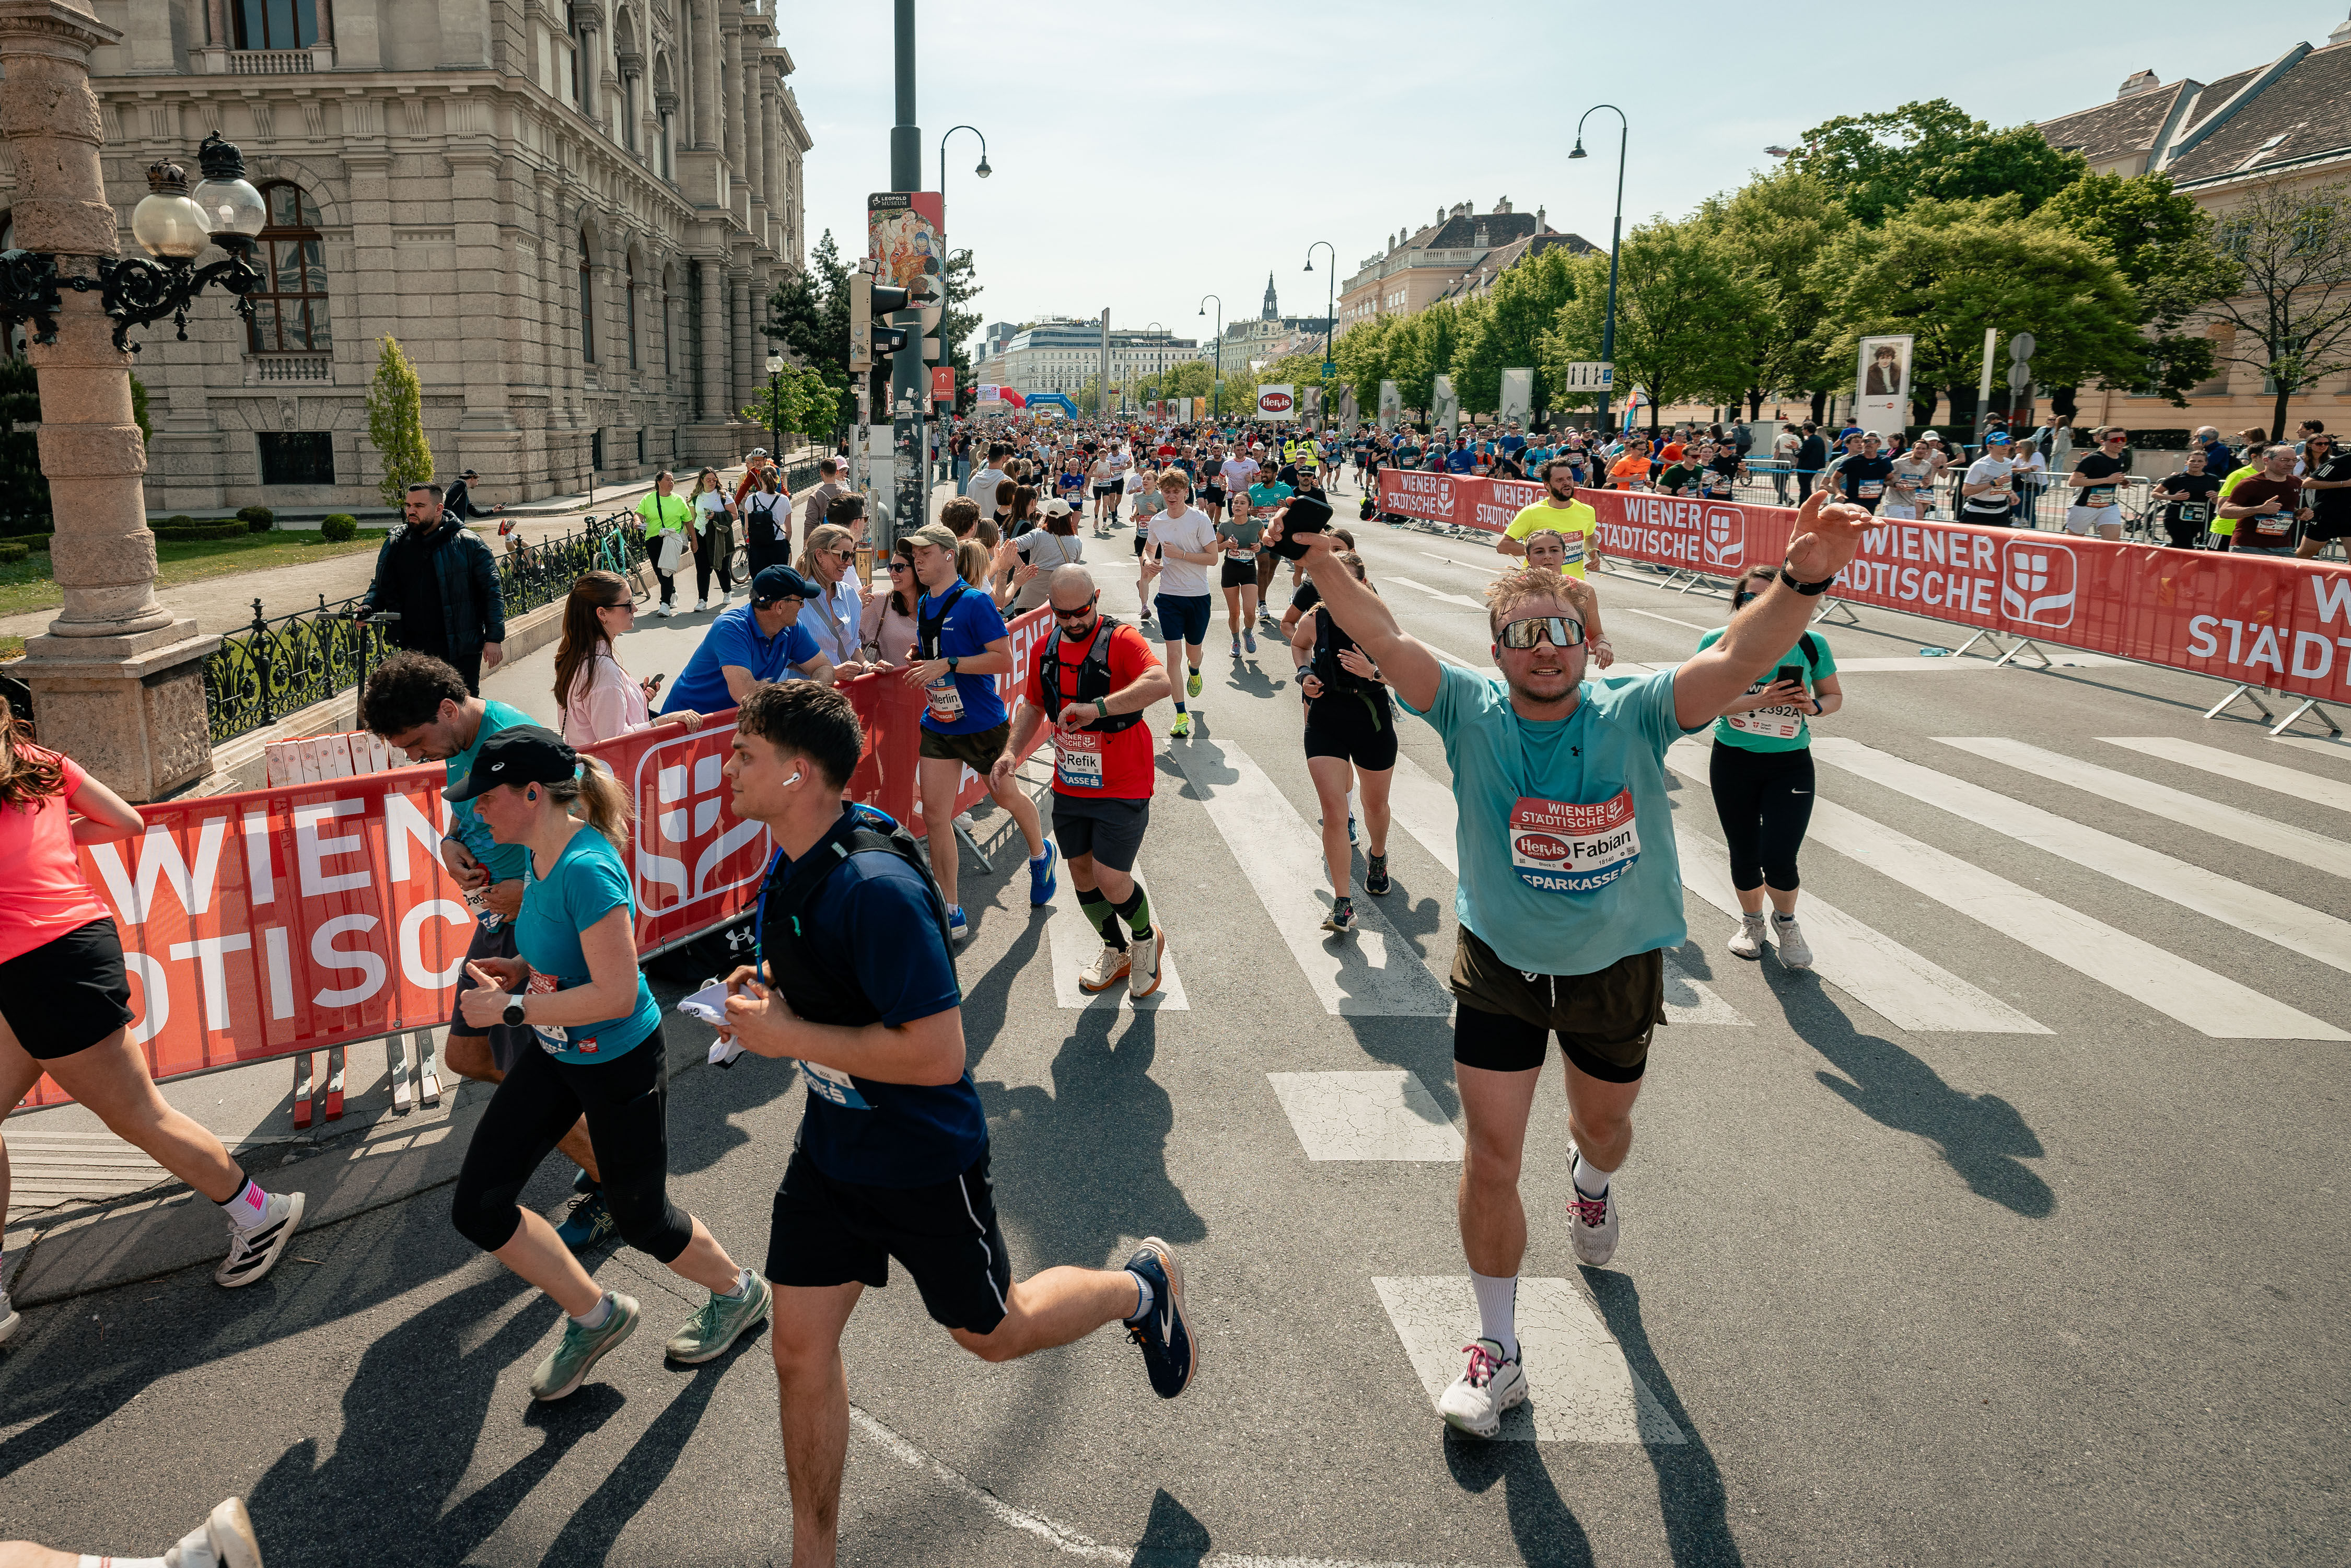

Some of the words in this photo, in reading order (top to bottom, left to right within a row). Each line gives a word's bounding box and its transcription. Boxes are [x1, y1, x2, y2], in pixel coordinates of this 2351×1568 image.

[1263, 398, 1290, 408] Hervis
[1402, 474, 1437, 494] WIENER
[1388, 492, 1436, 515] STÄDTISCHE
[1493, 483, 1533, 506] WIENER
[1624, 497, 1702, 530] WIENER
[1565, 543, 1582, 552] Daniel
[1595, 522, 1700, 562] STÄDTISCHE
[1863, 525, 1996, 573] WIENER
[1832, 559, 1995, 615] ÄDTISCHE
[933, 693, 958, 704] Merlin
[1067, 753, 1097, 767] Refik
[1521, 811, 1605, 828] STÄDTISCHE
[1548, 803, 1604, 817] WIENER
[1521, 838, 1566, 856] Hervis
[1573, 831, 1631, 858] Fabian
[1599, 856, 1614, 866] 18140
[1522, 869, 1619, 890] SPARKASSE
